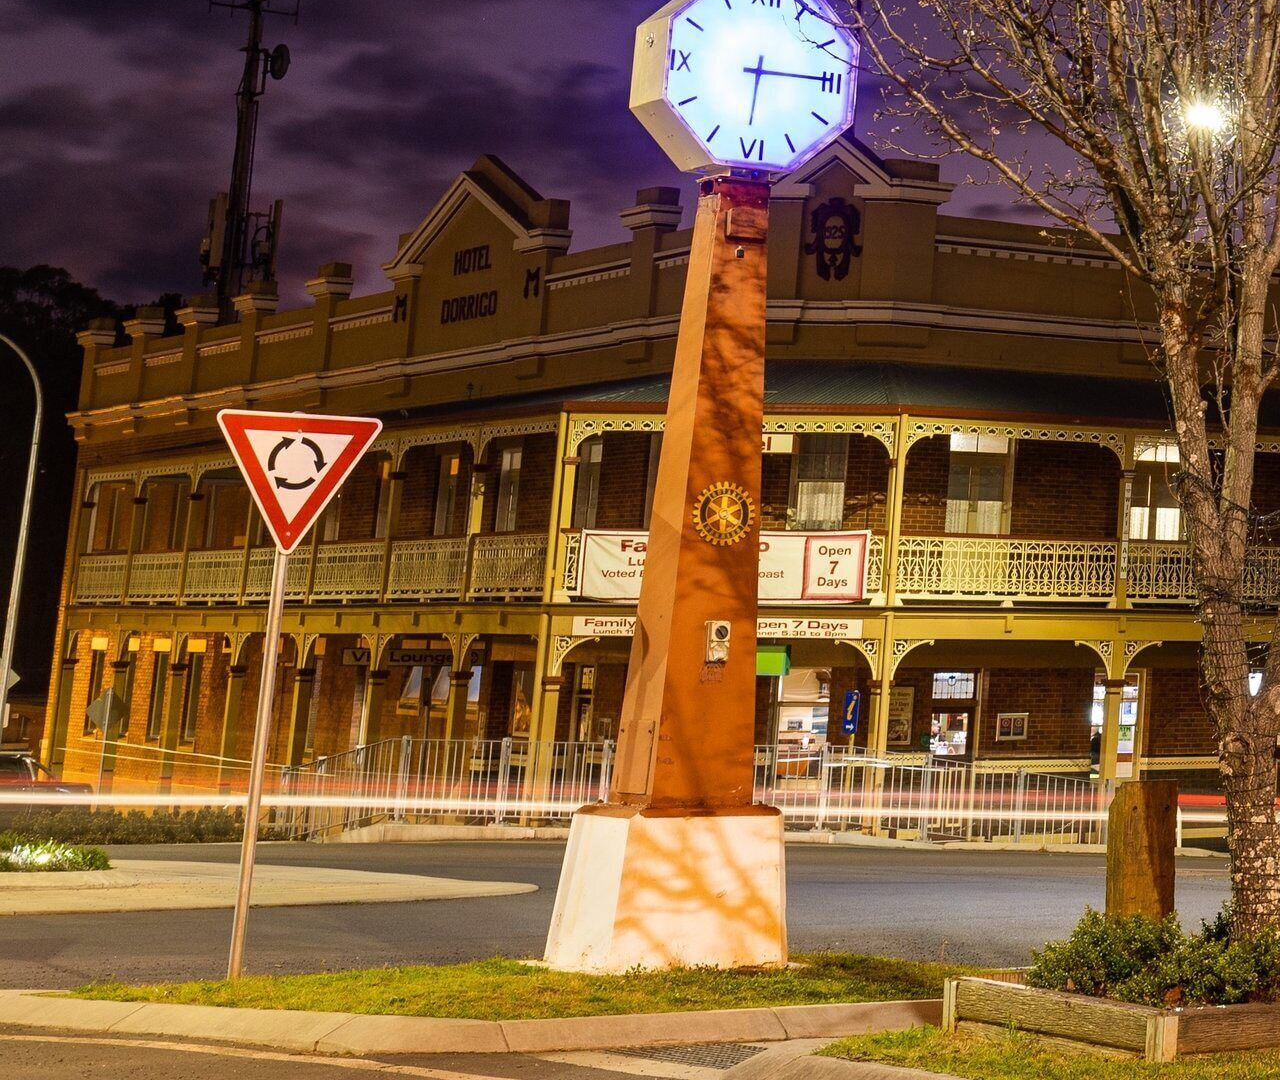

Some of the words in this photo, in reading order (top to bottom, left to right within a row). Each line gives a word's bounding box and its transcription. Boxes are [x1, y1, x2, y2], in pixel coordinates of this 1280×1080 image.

[453, 245, 491, 276] HOTEL
[440, 290, 498, 325] DORRIGO
[818, 545, 852, 557] Open
[601, 570, 636, 578] Voted
[829, 561, 839, 575] 7
[817, 577, 848, 589] Days
[584, 618, 636, 628] Family
[792, 621, 803, 629] 7
[807, 621, 848, 631] Days
[390, 651, 455, 664] Lounge
